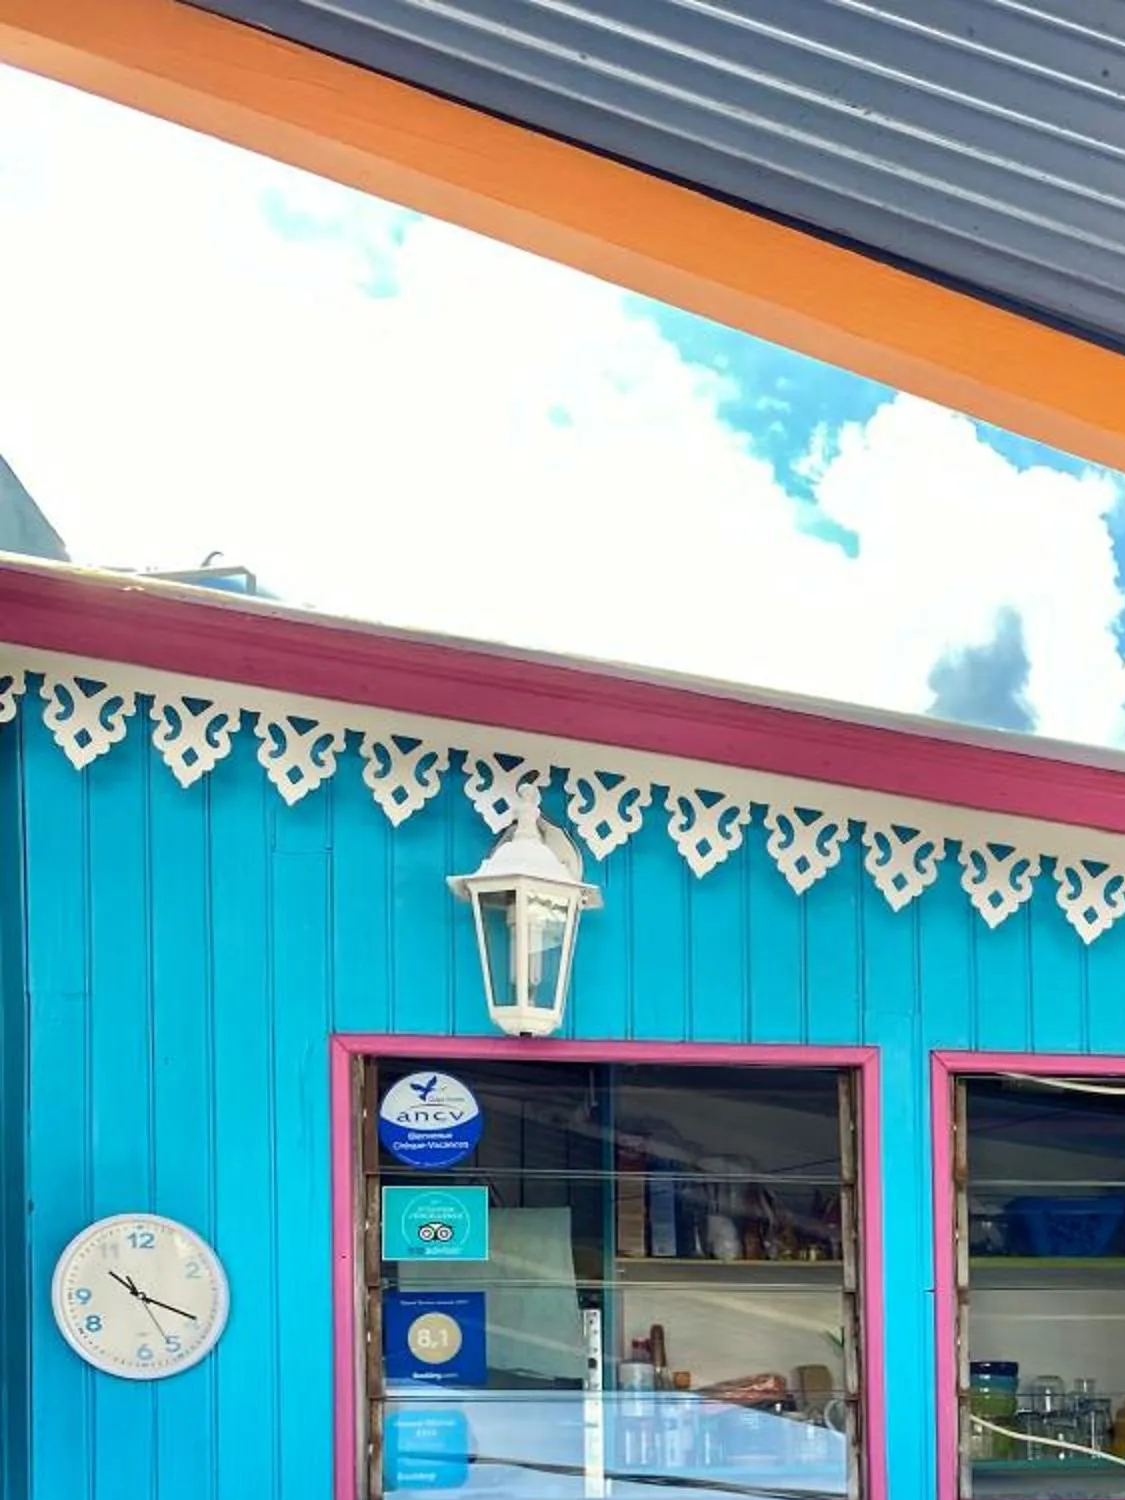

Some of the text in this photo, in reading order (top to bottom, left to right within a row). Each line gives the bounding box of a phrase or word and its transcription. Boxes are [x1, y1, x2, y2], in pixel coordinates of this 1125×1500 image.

[397, 1111, 464, 1122] ancv
[127, 1232, 155, 1249] 12
[184, 1261, 201, 1279] 2
[75, 1288, 92, 1305] 9
[85, 1315, 102, 1332] 8
[165, 1335, 181, 1352] 5
[417, 1328, 449, 1348] 8,1
[136, 1343, 153, 1360] 6
